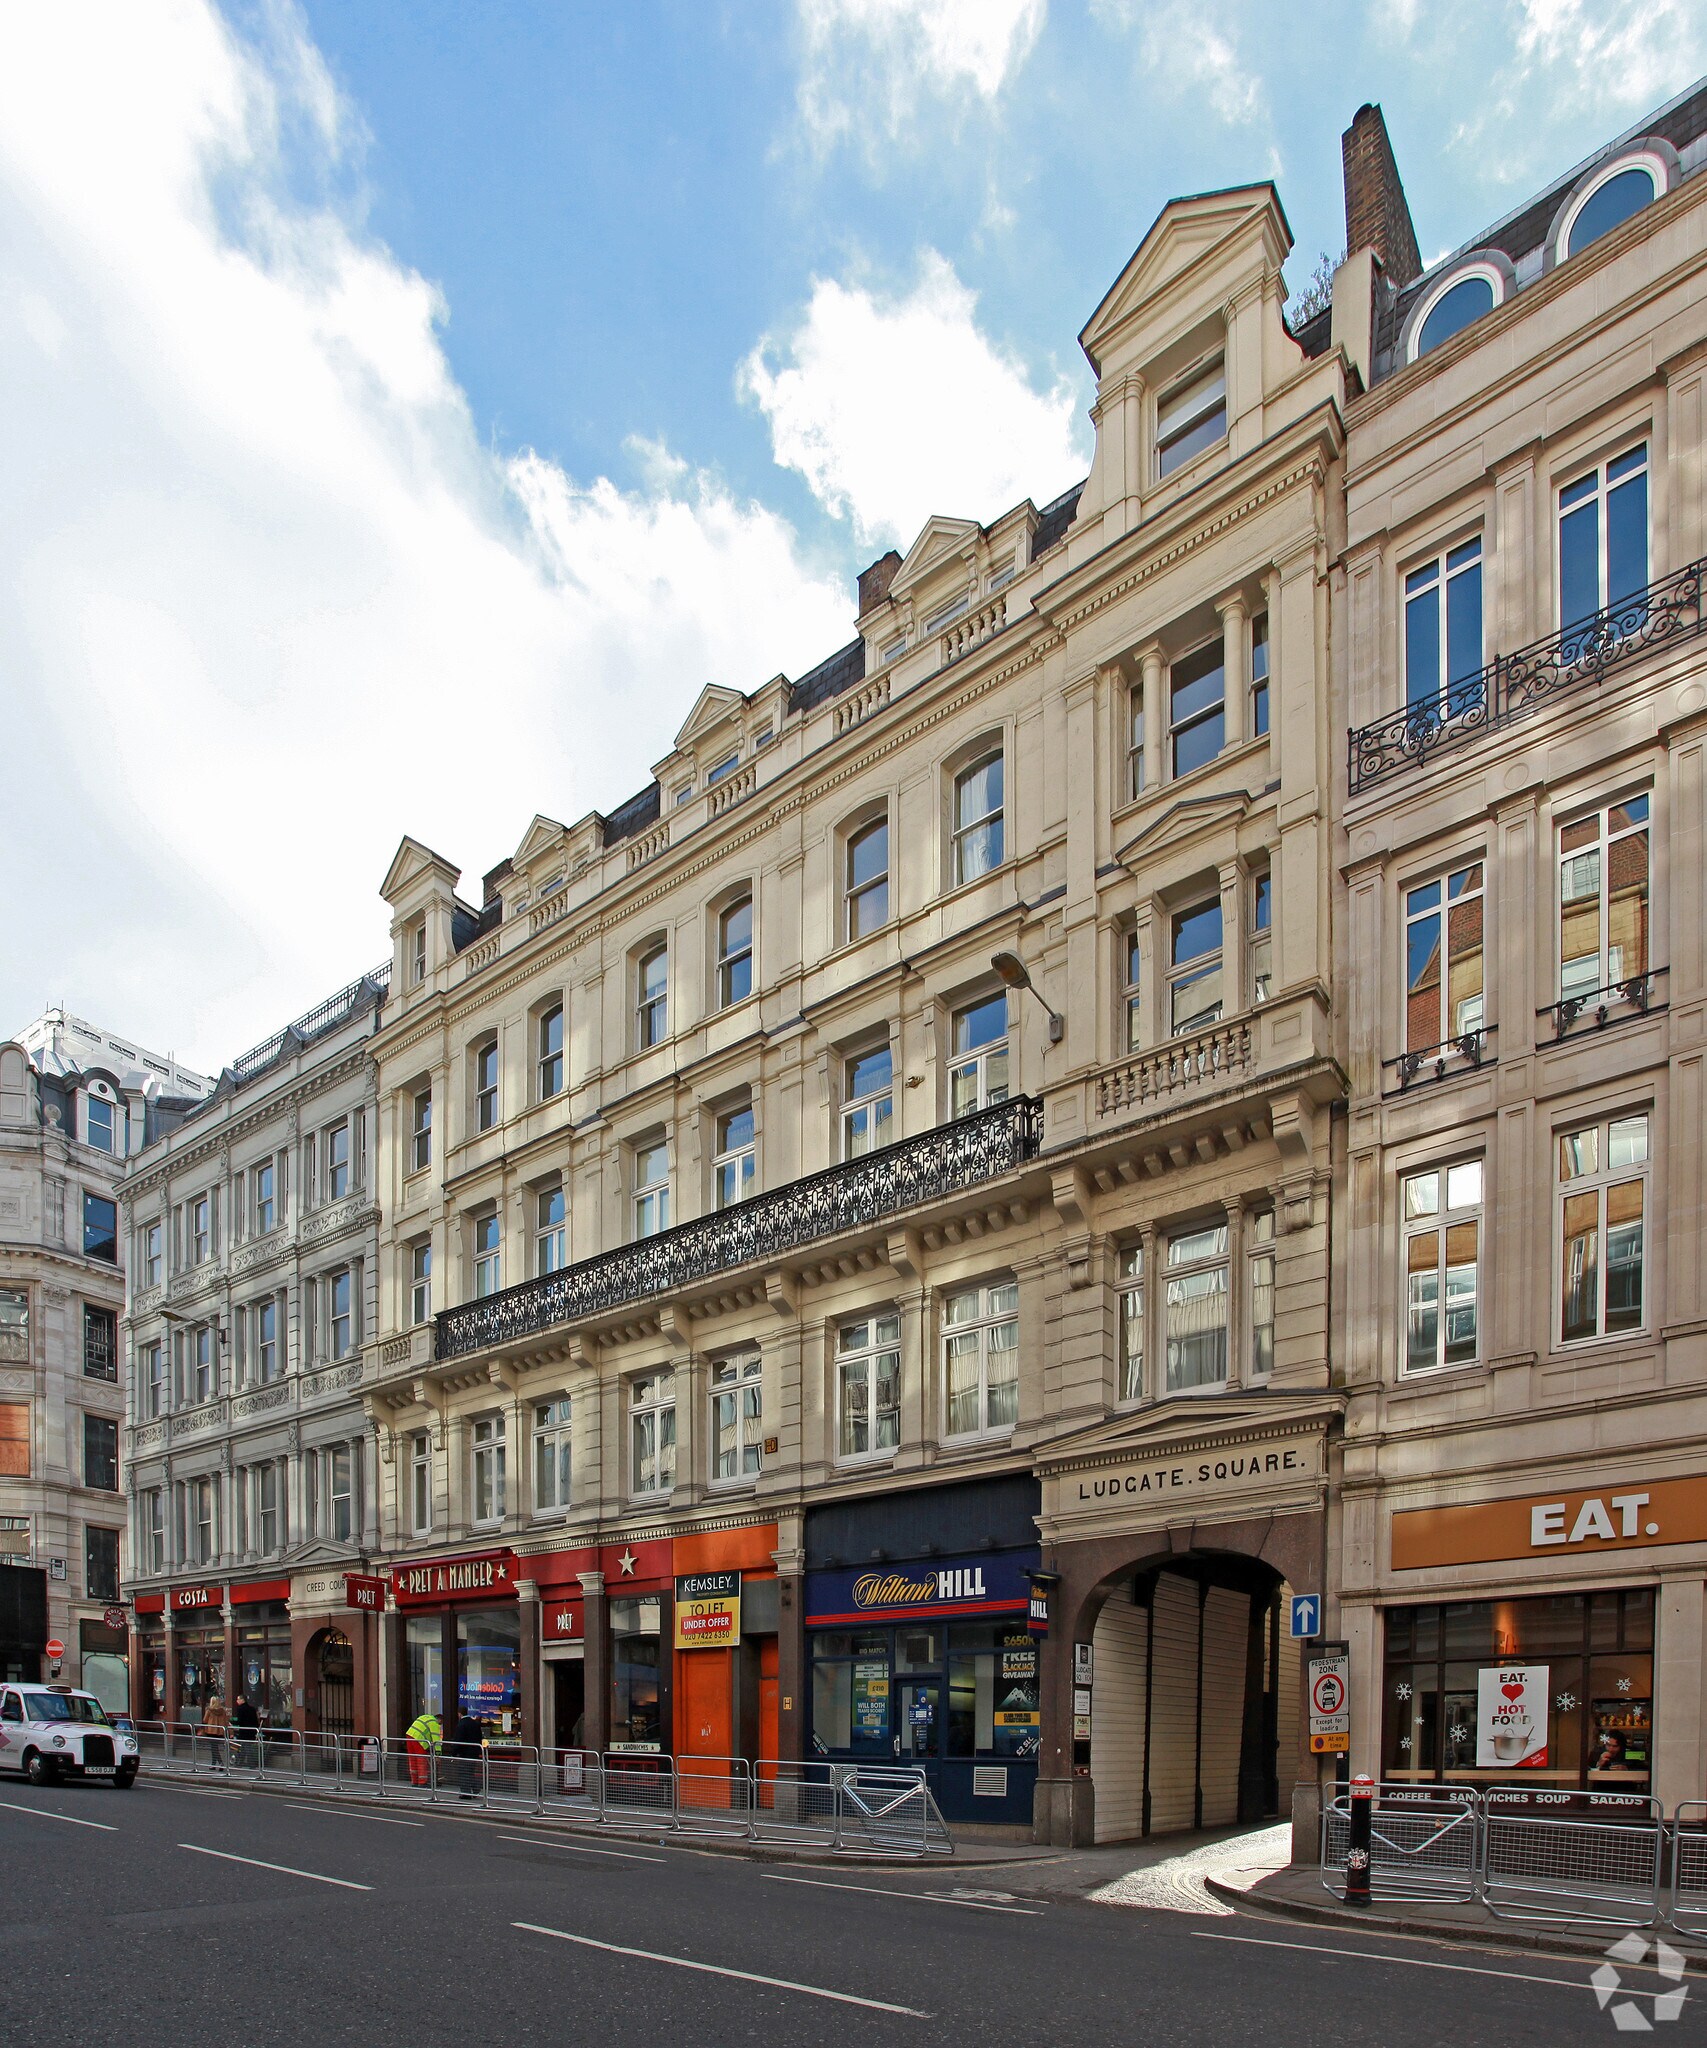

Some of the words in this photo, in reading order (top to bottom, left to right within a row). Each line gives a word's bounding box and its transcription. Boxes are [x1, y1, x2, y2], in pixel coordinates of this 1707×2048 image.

[1530, 1492, 1660, 1547] EAT.
[409, 1567, 432, 1594] PRET
[437, 1569, 444, 1591] A
[450, 1561, 494, 1590] MANGER
[684, 1575, 732, 1592] KEMSLEY
[306, 1581, 326, 1593] CREED
[329, 1579, 347, 1591] COUR
[853, 1571, 939, 1610] William
[938, 1567, 986, 1599] HILL
[179, 1589, 208, 1606] COSTA
[357, 1588, 376, 1605] PRET
[690, 1603, 705, 1616] TO
[708, 1602, 725, 1614] LET
[1030, 1599, 1048, 1619] HILL
[557, 1613, 573, 1630] PRET
[683, 1619, 706, 1630] UNDER
[707, 1616, 730, 1627] OFFER
[697, 1632, 713, 1640] 7422
[714, 1630, 730, 1639] 6350
[1002, 1652, 1036, 1662] FREE
[1311, 1657, 1346, 1667] PEDESTRIAN
[1002, 1661, 1036, 1672] BLACKJACK
[1319, 1665, 1338, 1674] ZONE
[1002, 1671, 1035, 1679] GIVEAWAY
[1499, 1672, 1528, 1684] EAT.
[1497, 1704, 1526, 1715] HOT
[1315, 1718, 1333, 1727] Except
[1491, 1715, 1531, 1726] FOOD
[1388, 1792, 1431, 1800] COFFEE
[1535, 1794, 1571, 1804] SOUP
[1589, 1796, 1644, 1806] SALADS
